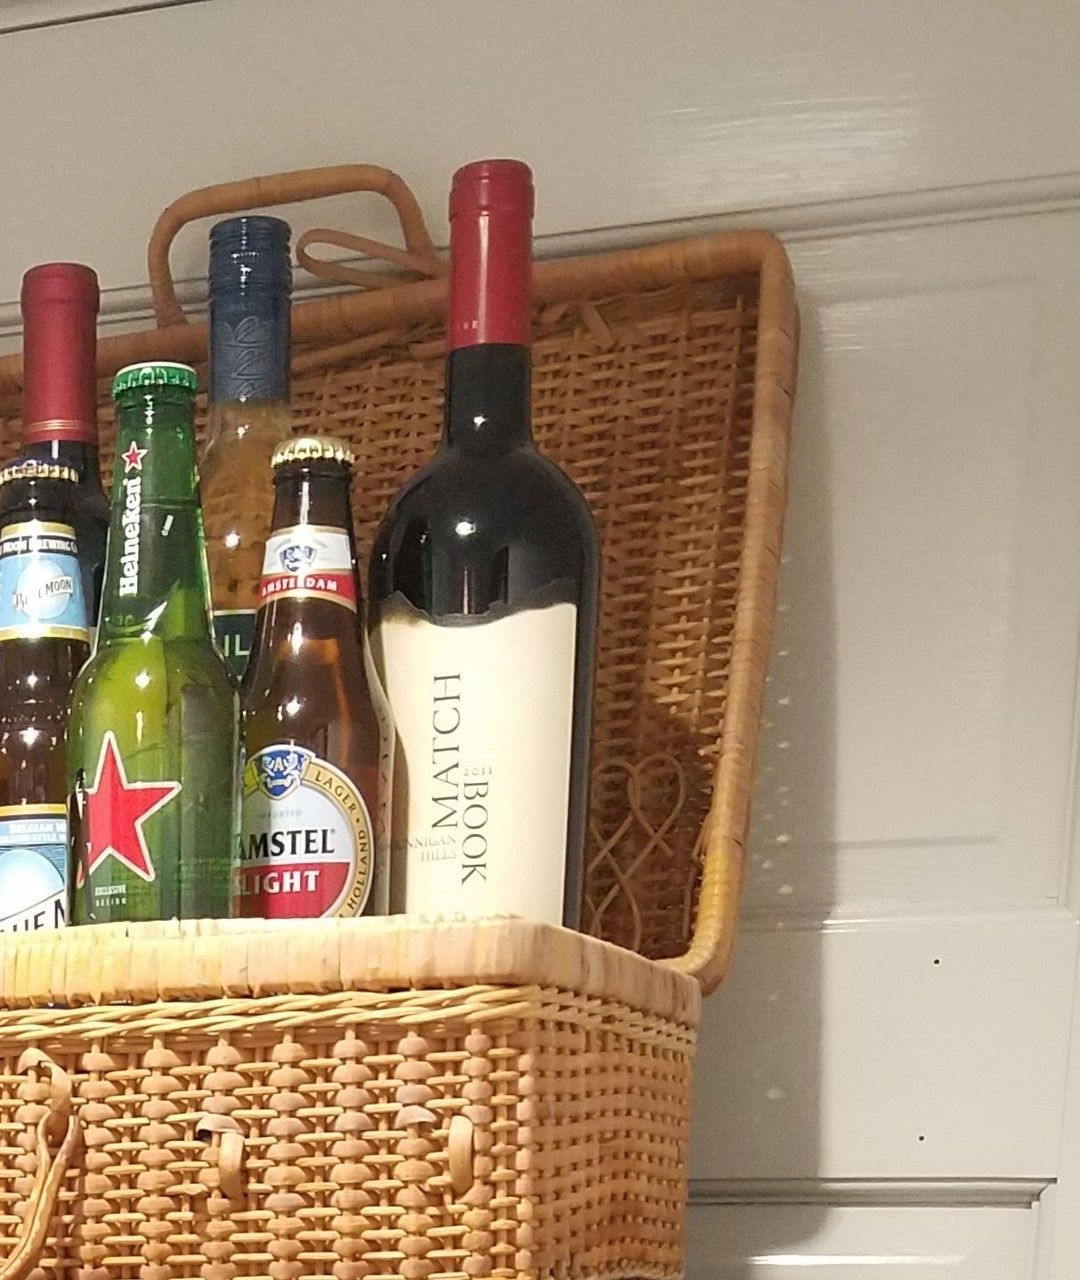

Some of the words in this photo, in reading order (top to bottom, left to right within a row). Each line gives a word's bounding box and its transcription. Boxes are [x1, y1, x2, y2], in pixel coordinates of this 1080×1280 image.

[119, 476, 141, 596] Heineken
[431, 673, 461, 829] MATCH
[315, 770, 356, 814] LAGER
[239, 829, 335, 861] AMSTEL
[347, 830, 367, 911] HOLLAND
[461, 781, 489, 886] BOOK
[239, 869, 320, 896] LIGHT
